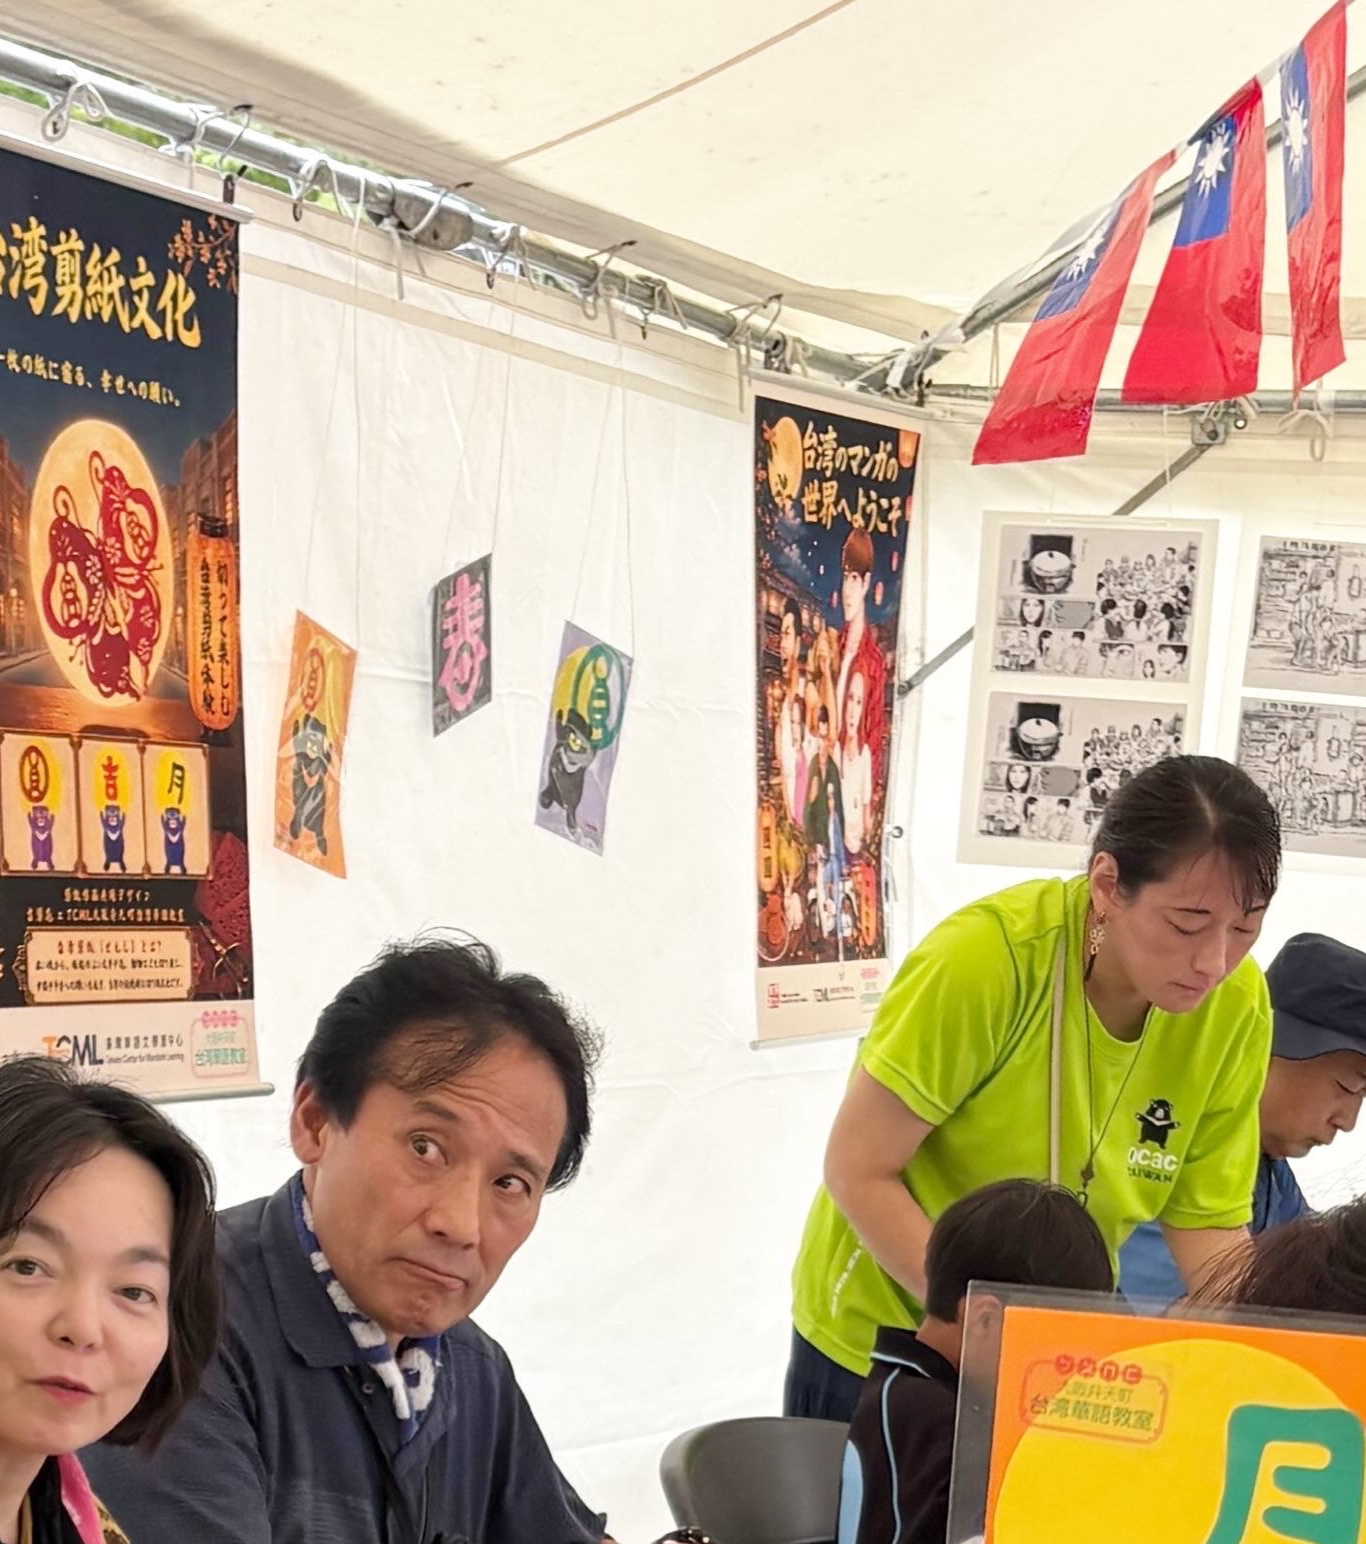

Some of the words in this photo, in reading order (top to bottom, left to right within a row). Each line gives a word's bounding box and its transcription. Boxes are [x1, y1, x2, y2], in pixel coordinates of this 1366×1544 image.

[802, 420, 899, 483] 台湾のマンガの
[801, 479, 903, 538] 世界へようこそ
[1127, 1146, 1179, 1172] ocac
